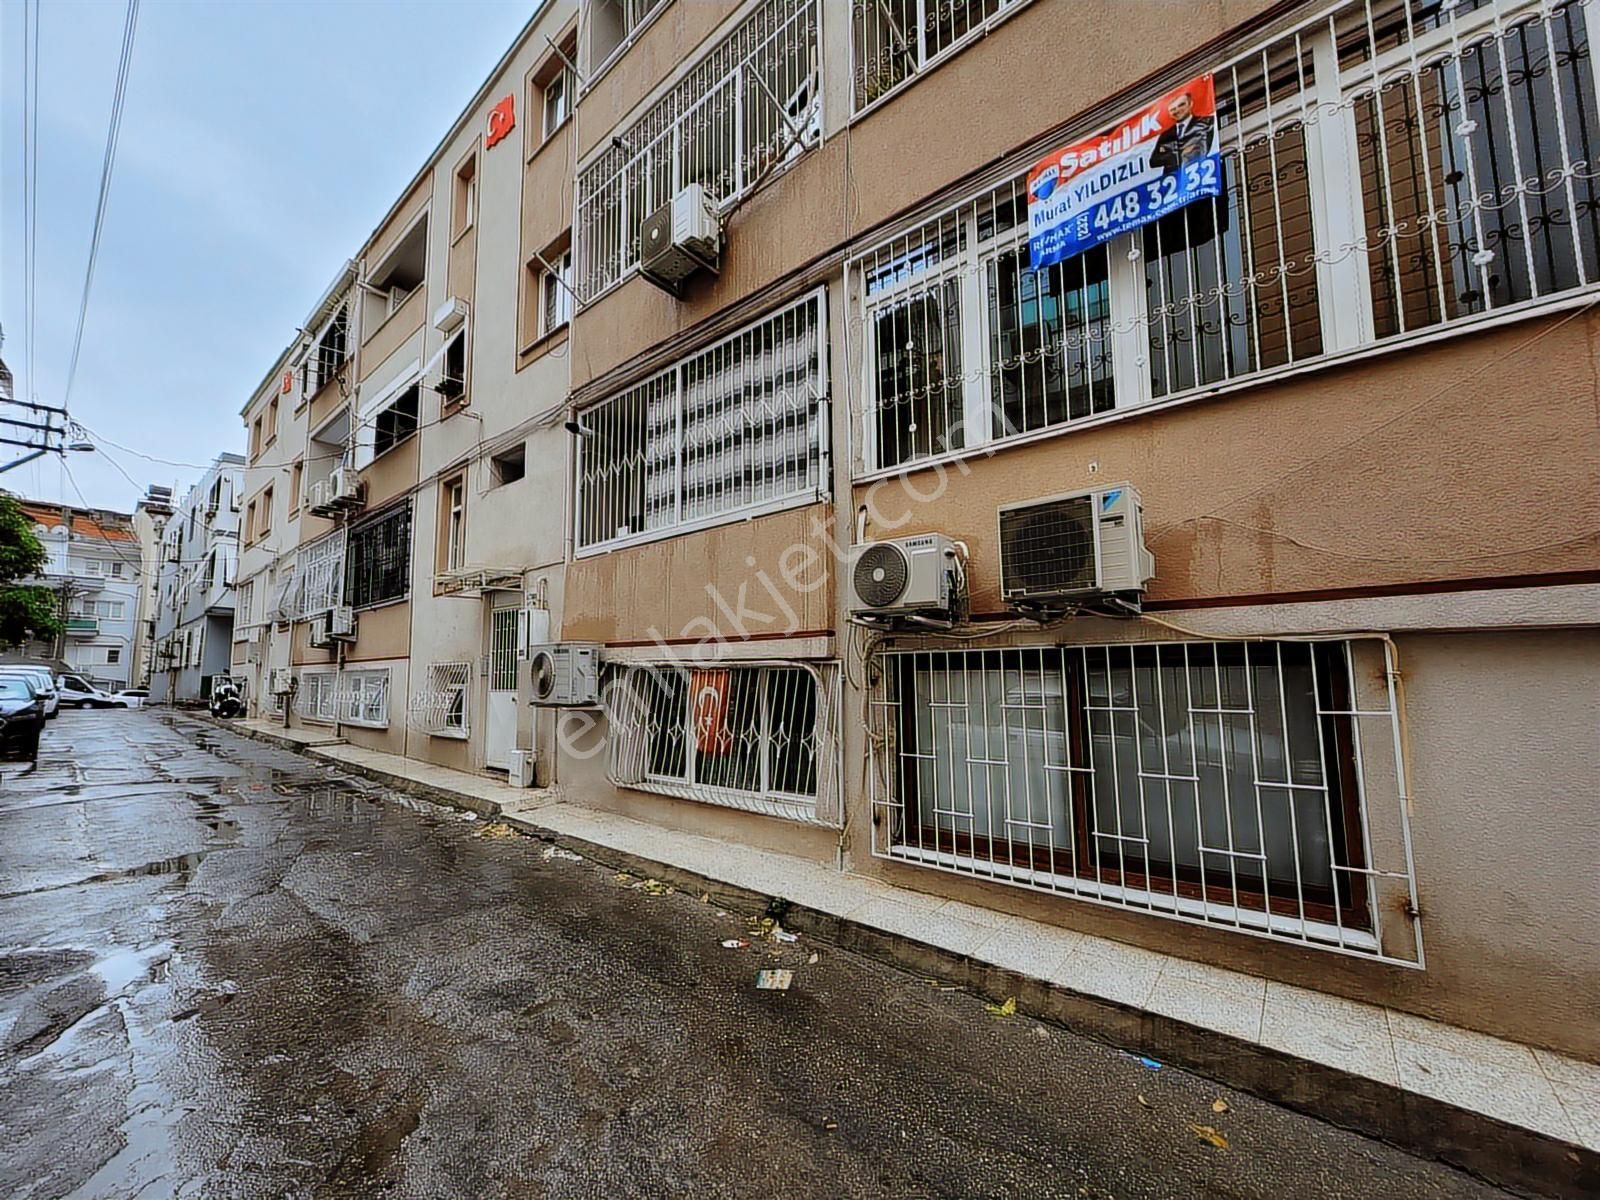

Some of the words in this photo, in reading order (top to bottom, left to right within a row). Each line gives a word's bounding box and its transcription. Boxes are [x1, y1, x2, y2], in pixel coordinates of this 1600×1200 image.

[1035, 195, 1071, 227] Murat
[1075, 157, 1144, 202] YILDIZLI
[1094, 191, 1140, 229] 448
[1147, 175, 1178, 210] 32
[1184, 159, 1217, 191] 32
[1033, 224, 1072, 250] RE/MAX
